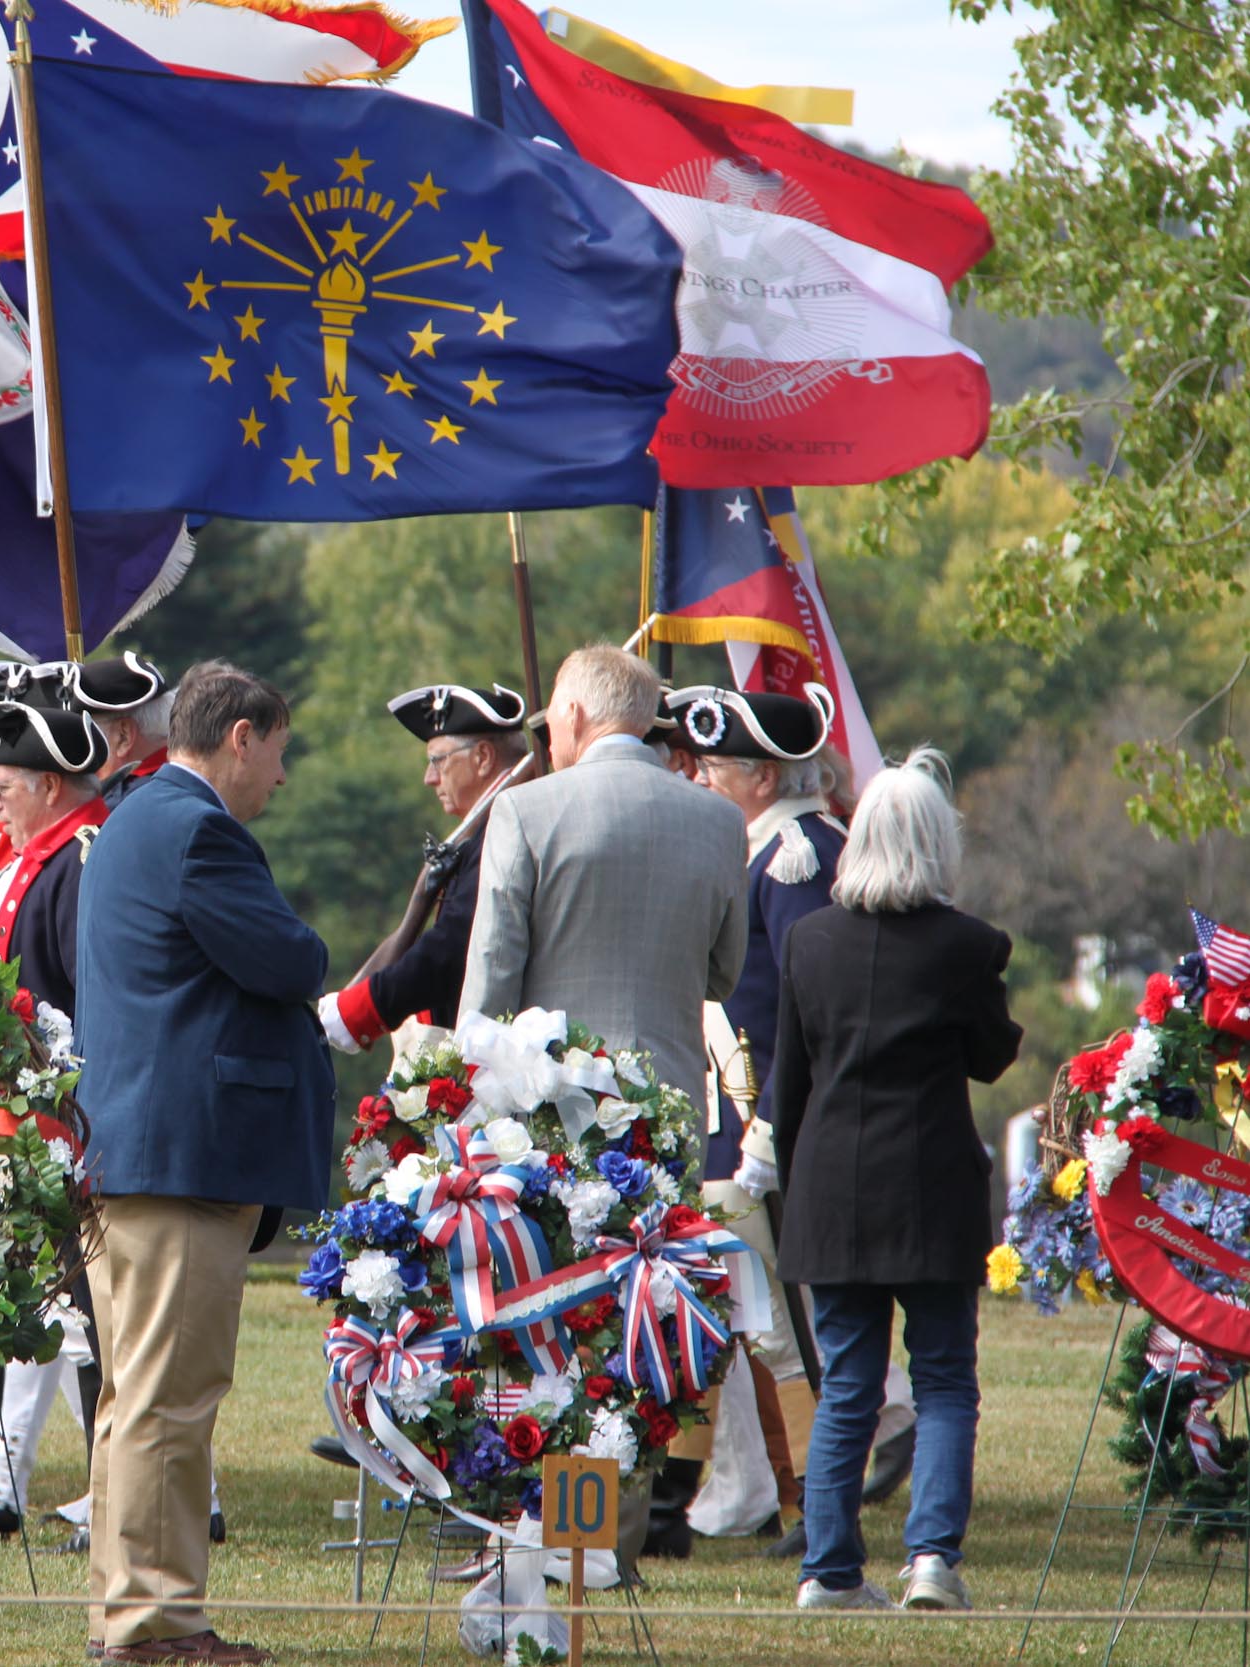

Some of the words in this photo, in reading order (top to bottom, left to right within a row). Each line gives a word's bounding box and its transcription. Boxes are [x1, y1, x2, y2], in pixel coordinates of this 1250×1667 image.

[303, 186, 396, 221] INDIANA
[726, 371, 790, 398] AMERICAN
[1135, 1215, 1217, 1264] American
[554, 1471, 606, 1533] 10
